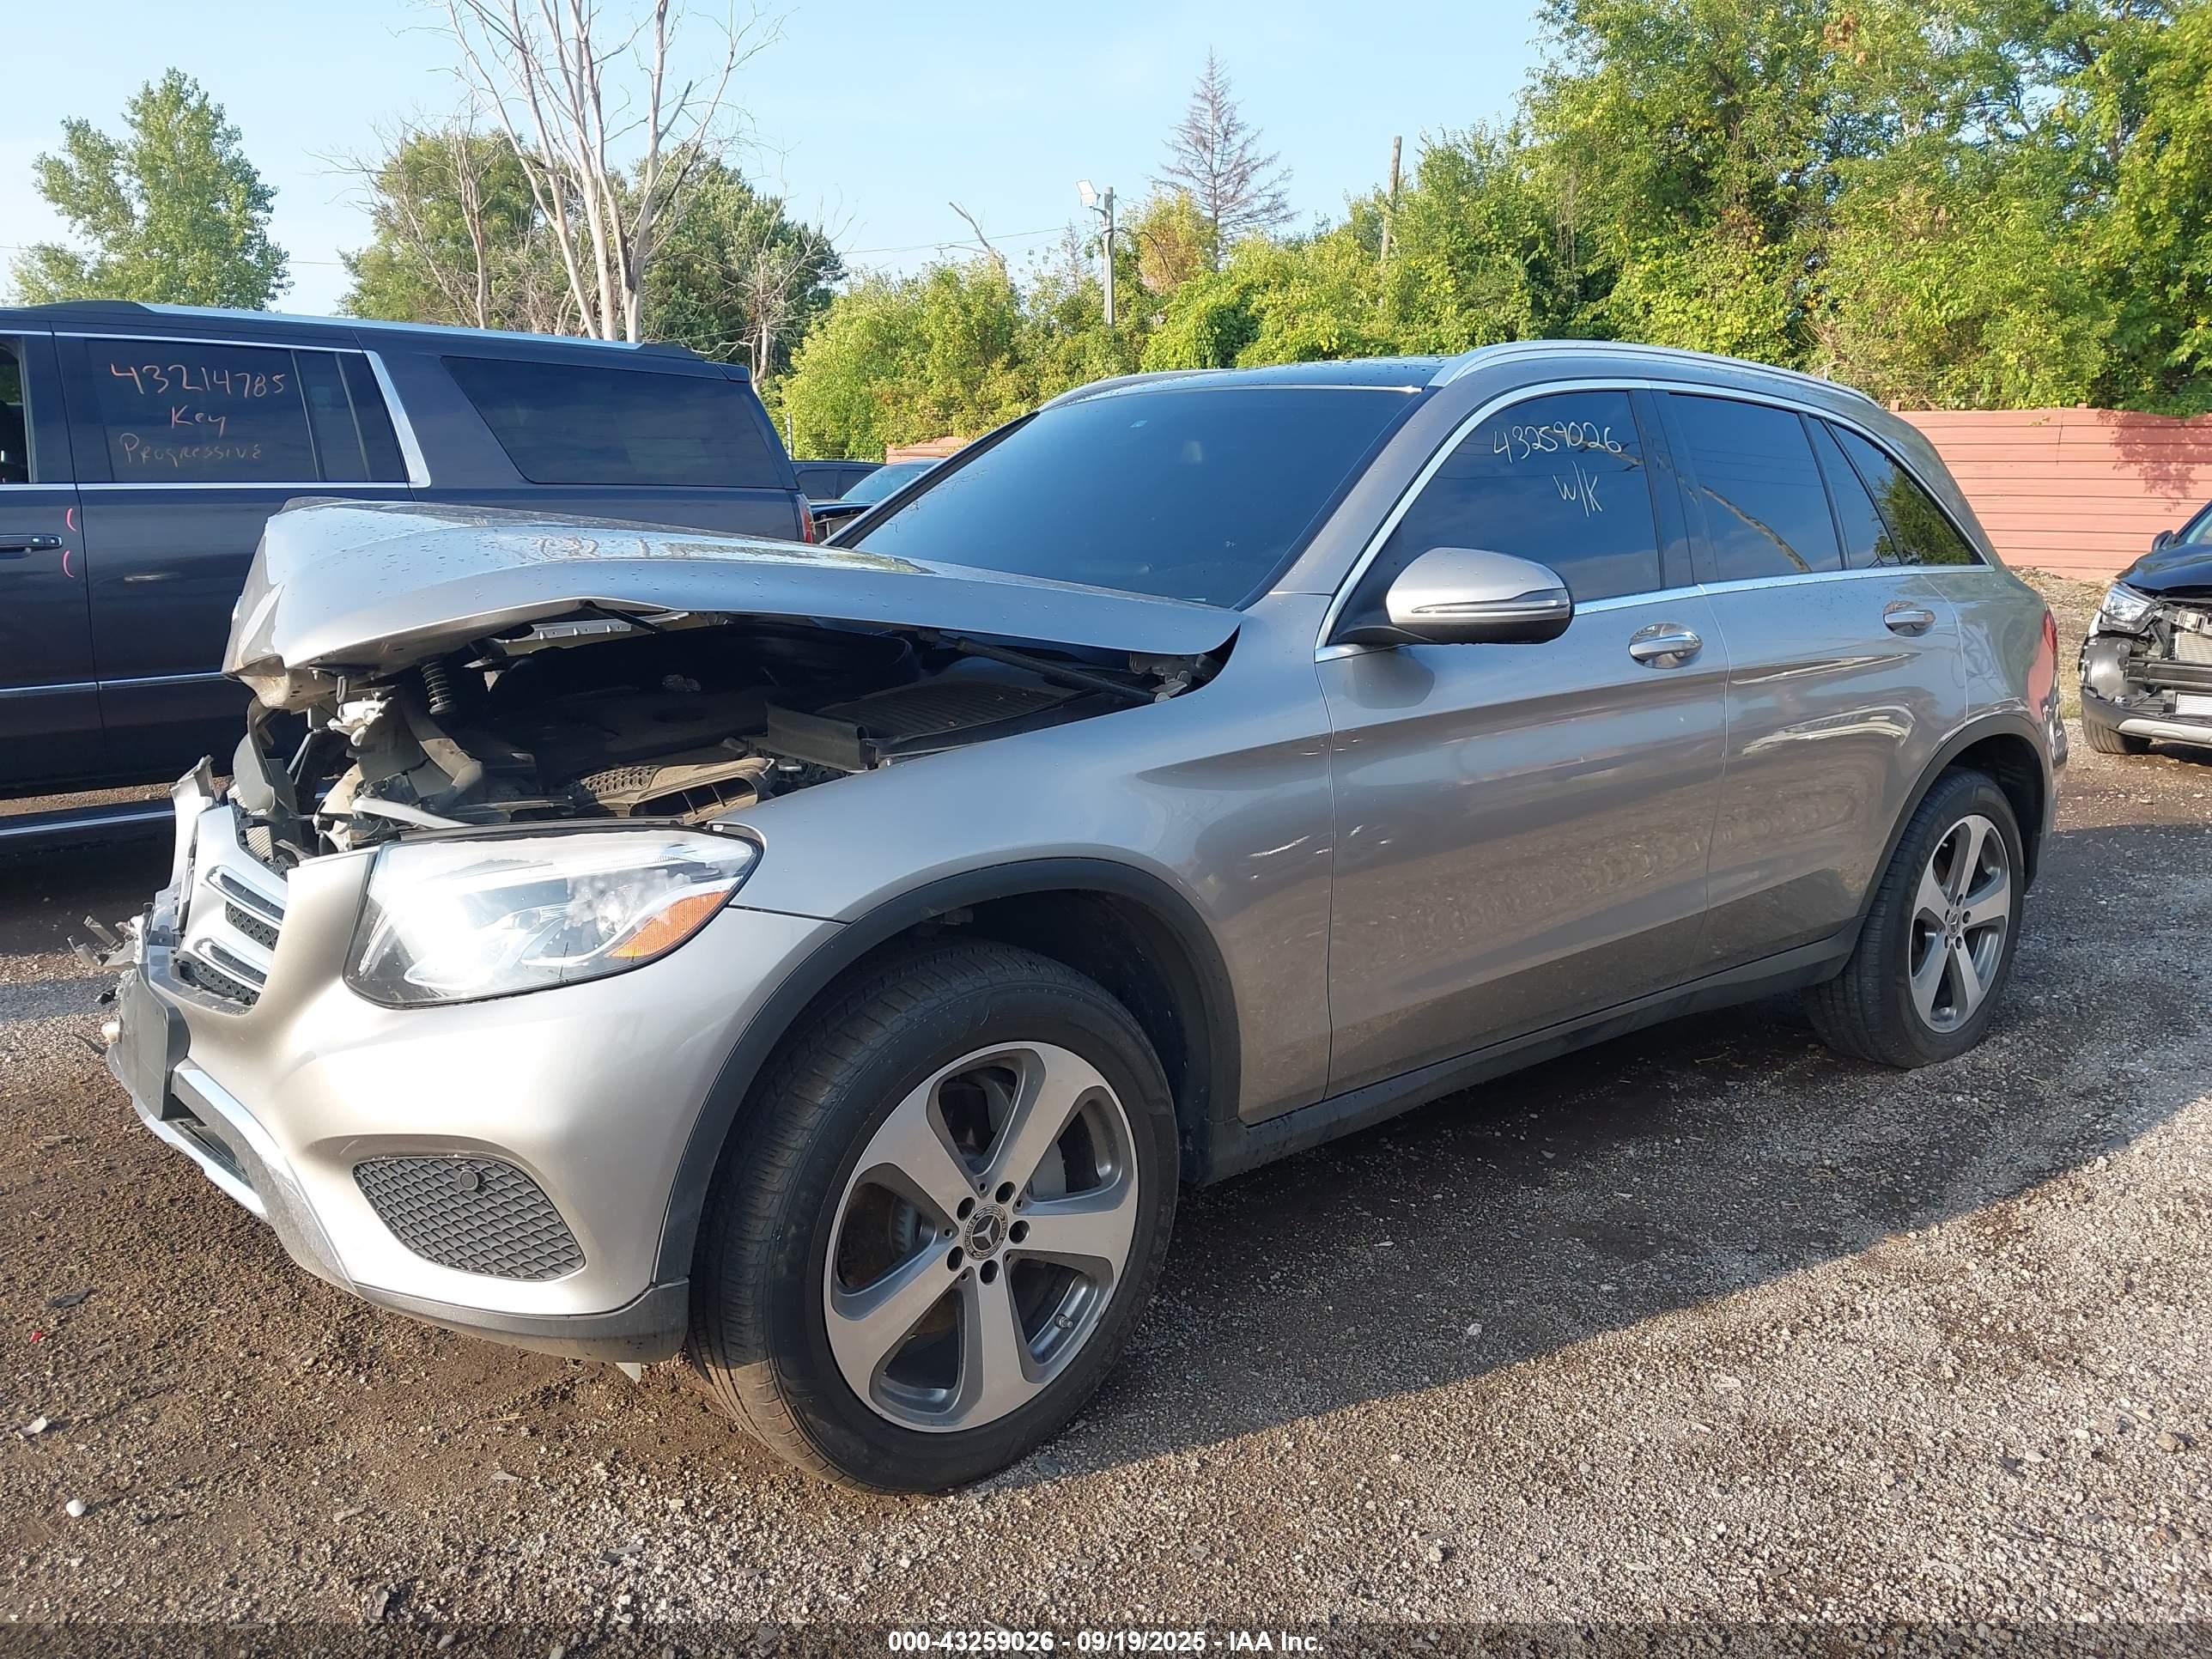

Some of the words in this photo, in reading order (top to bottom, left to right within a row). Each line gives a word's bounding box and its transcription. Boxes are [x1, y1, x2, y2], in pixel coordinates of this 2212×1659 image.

[110, 362, 286, 398] 43214785
[170, 404, 227, 438] Key
[1492, 420, 1623, 465] 43259026
